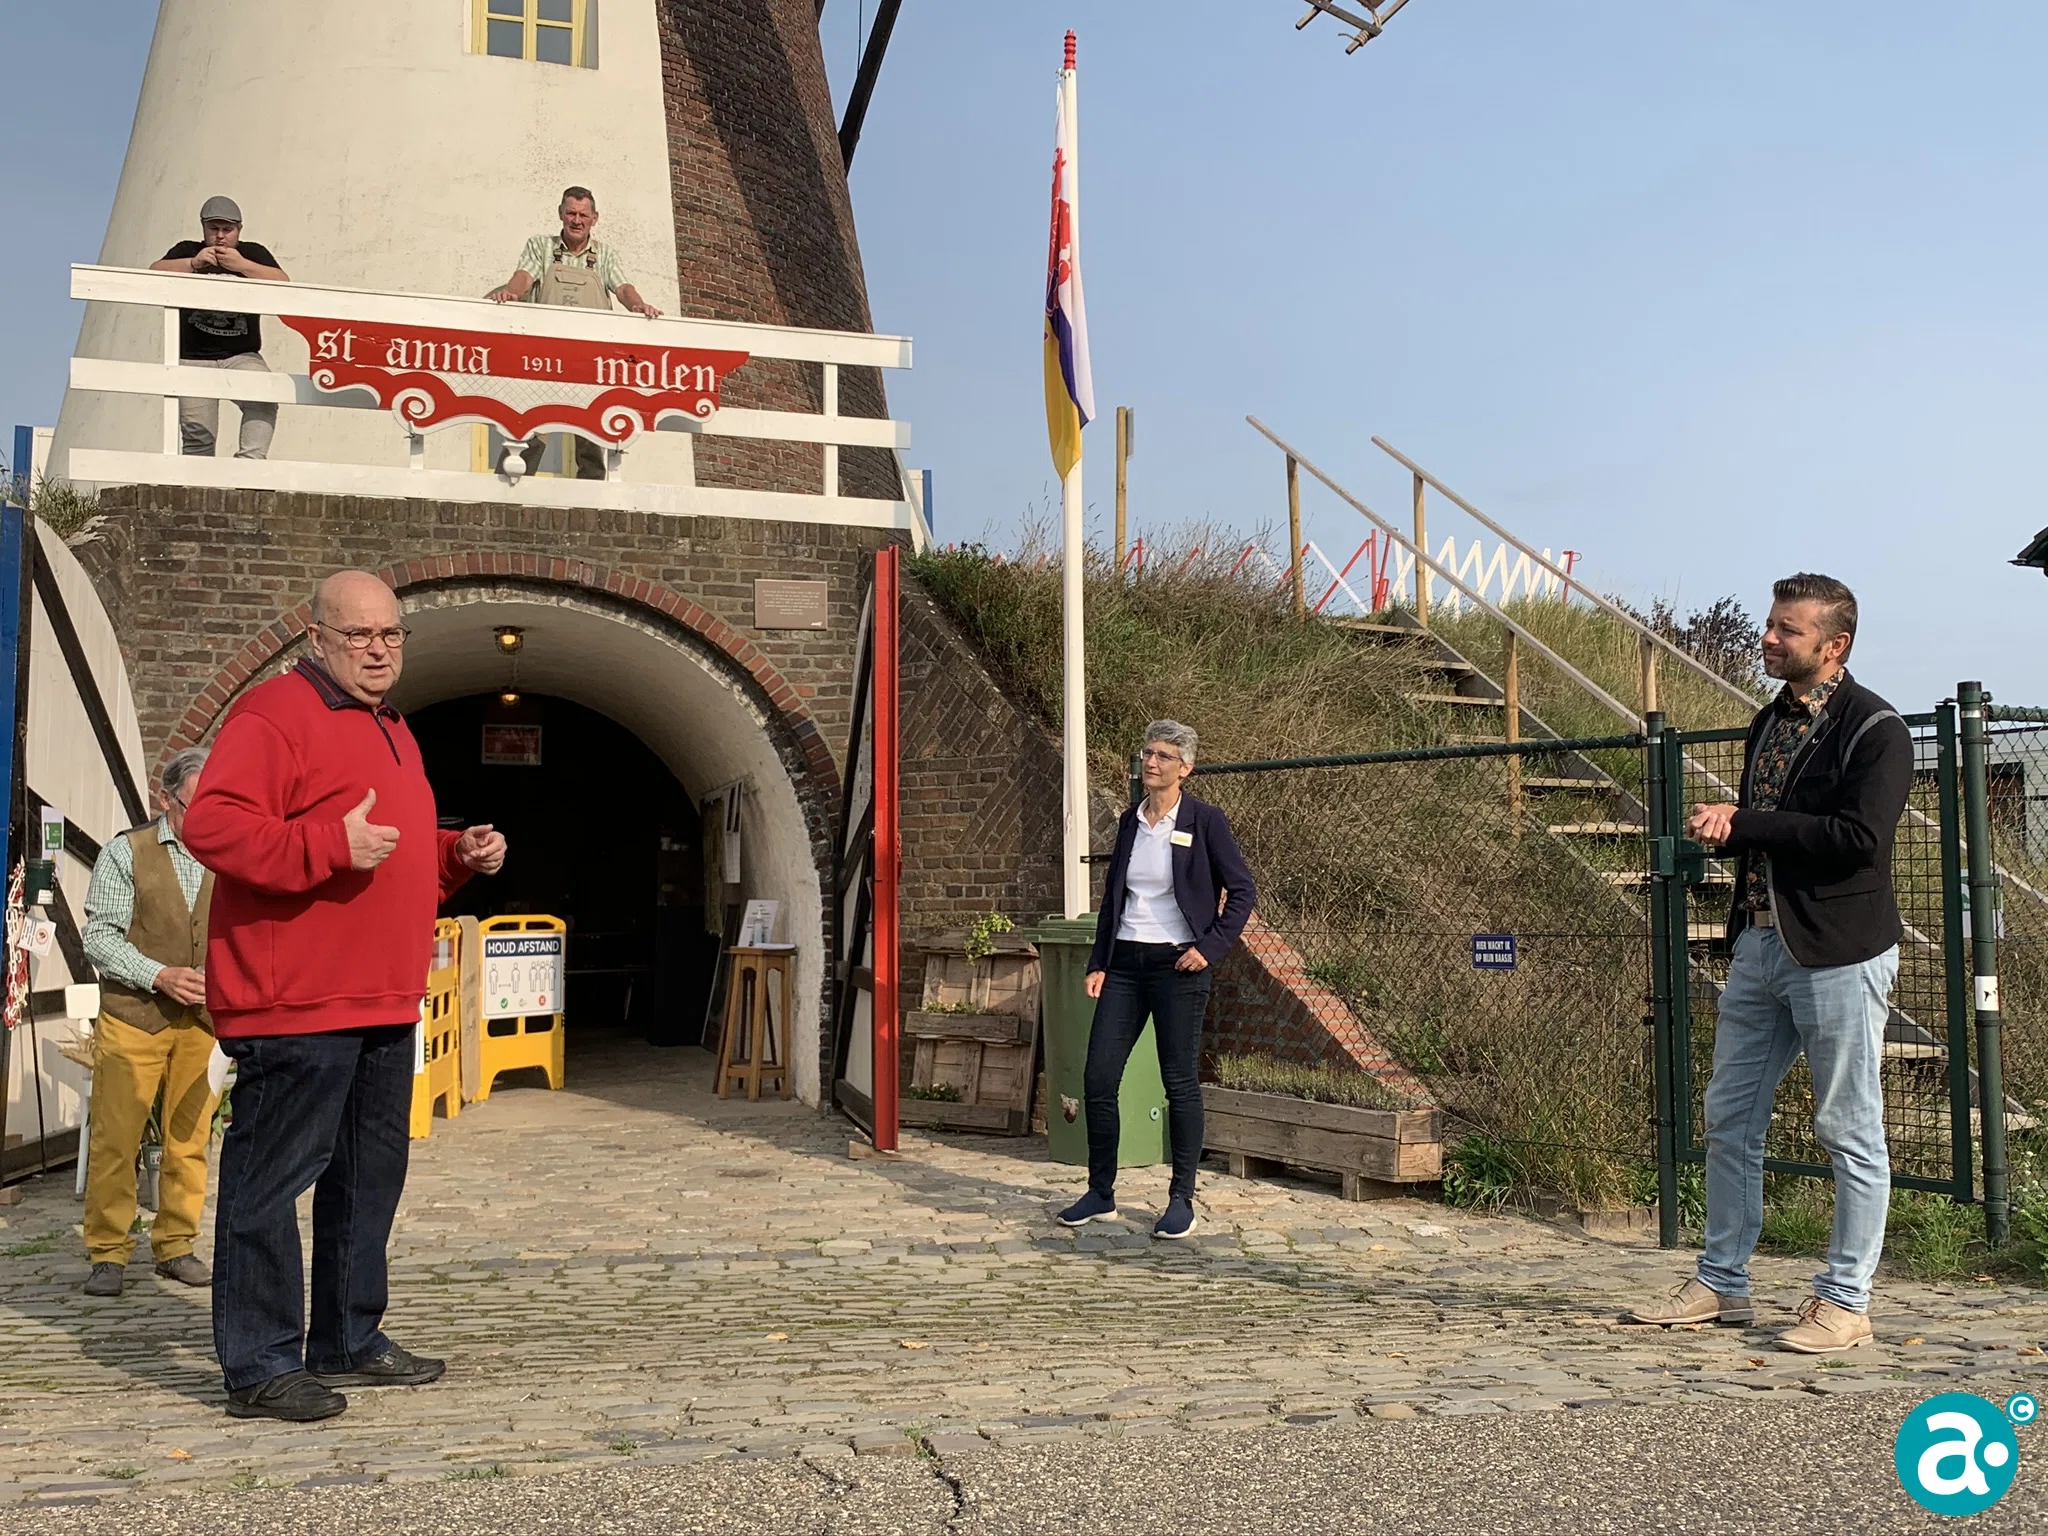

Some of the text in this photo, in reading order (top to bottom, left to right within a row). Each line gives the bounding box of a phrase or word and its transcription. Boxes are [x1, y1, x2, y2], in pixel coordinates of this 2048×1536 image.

[315, 327, 715, 392] st anna 1911 molen
[488, 941, 559, 954] HOUD AFSTAND
[1476, 941, 1511, 950] HIER WACHT IK
[1475, 953, 1482, 962] OP
